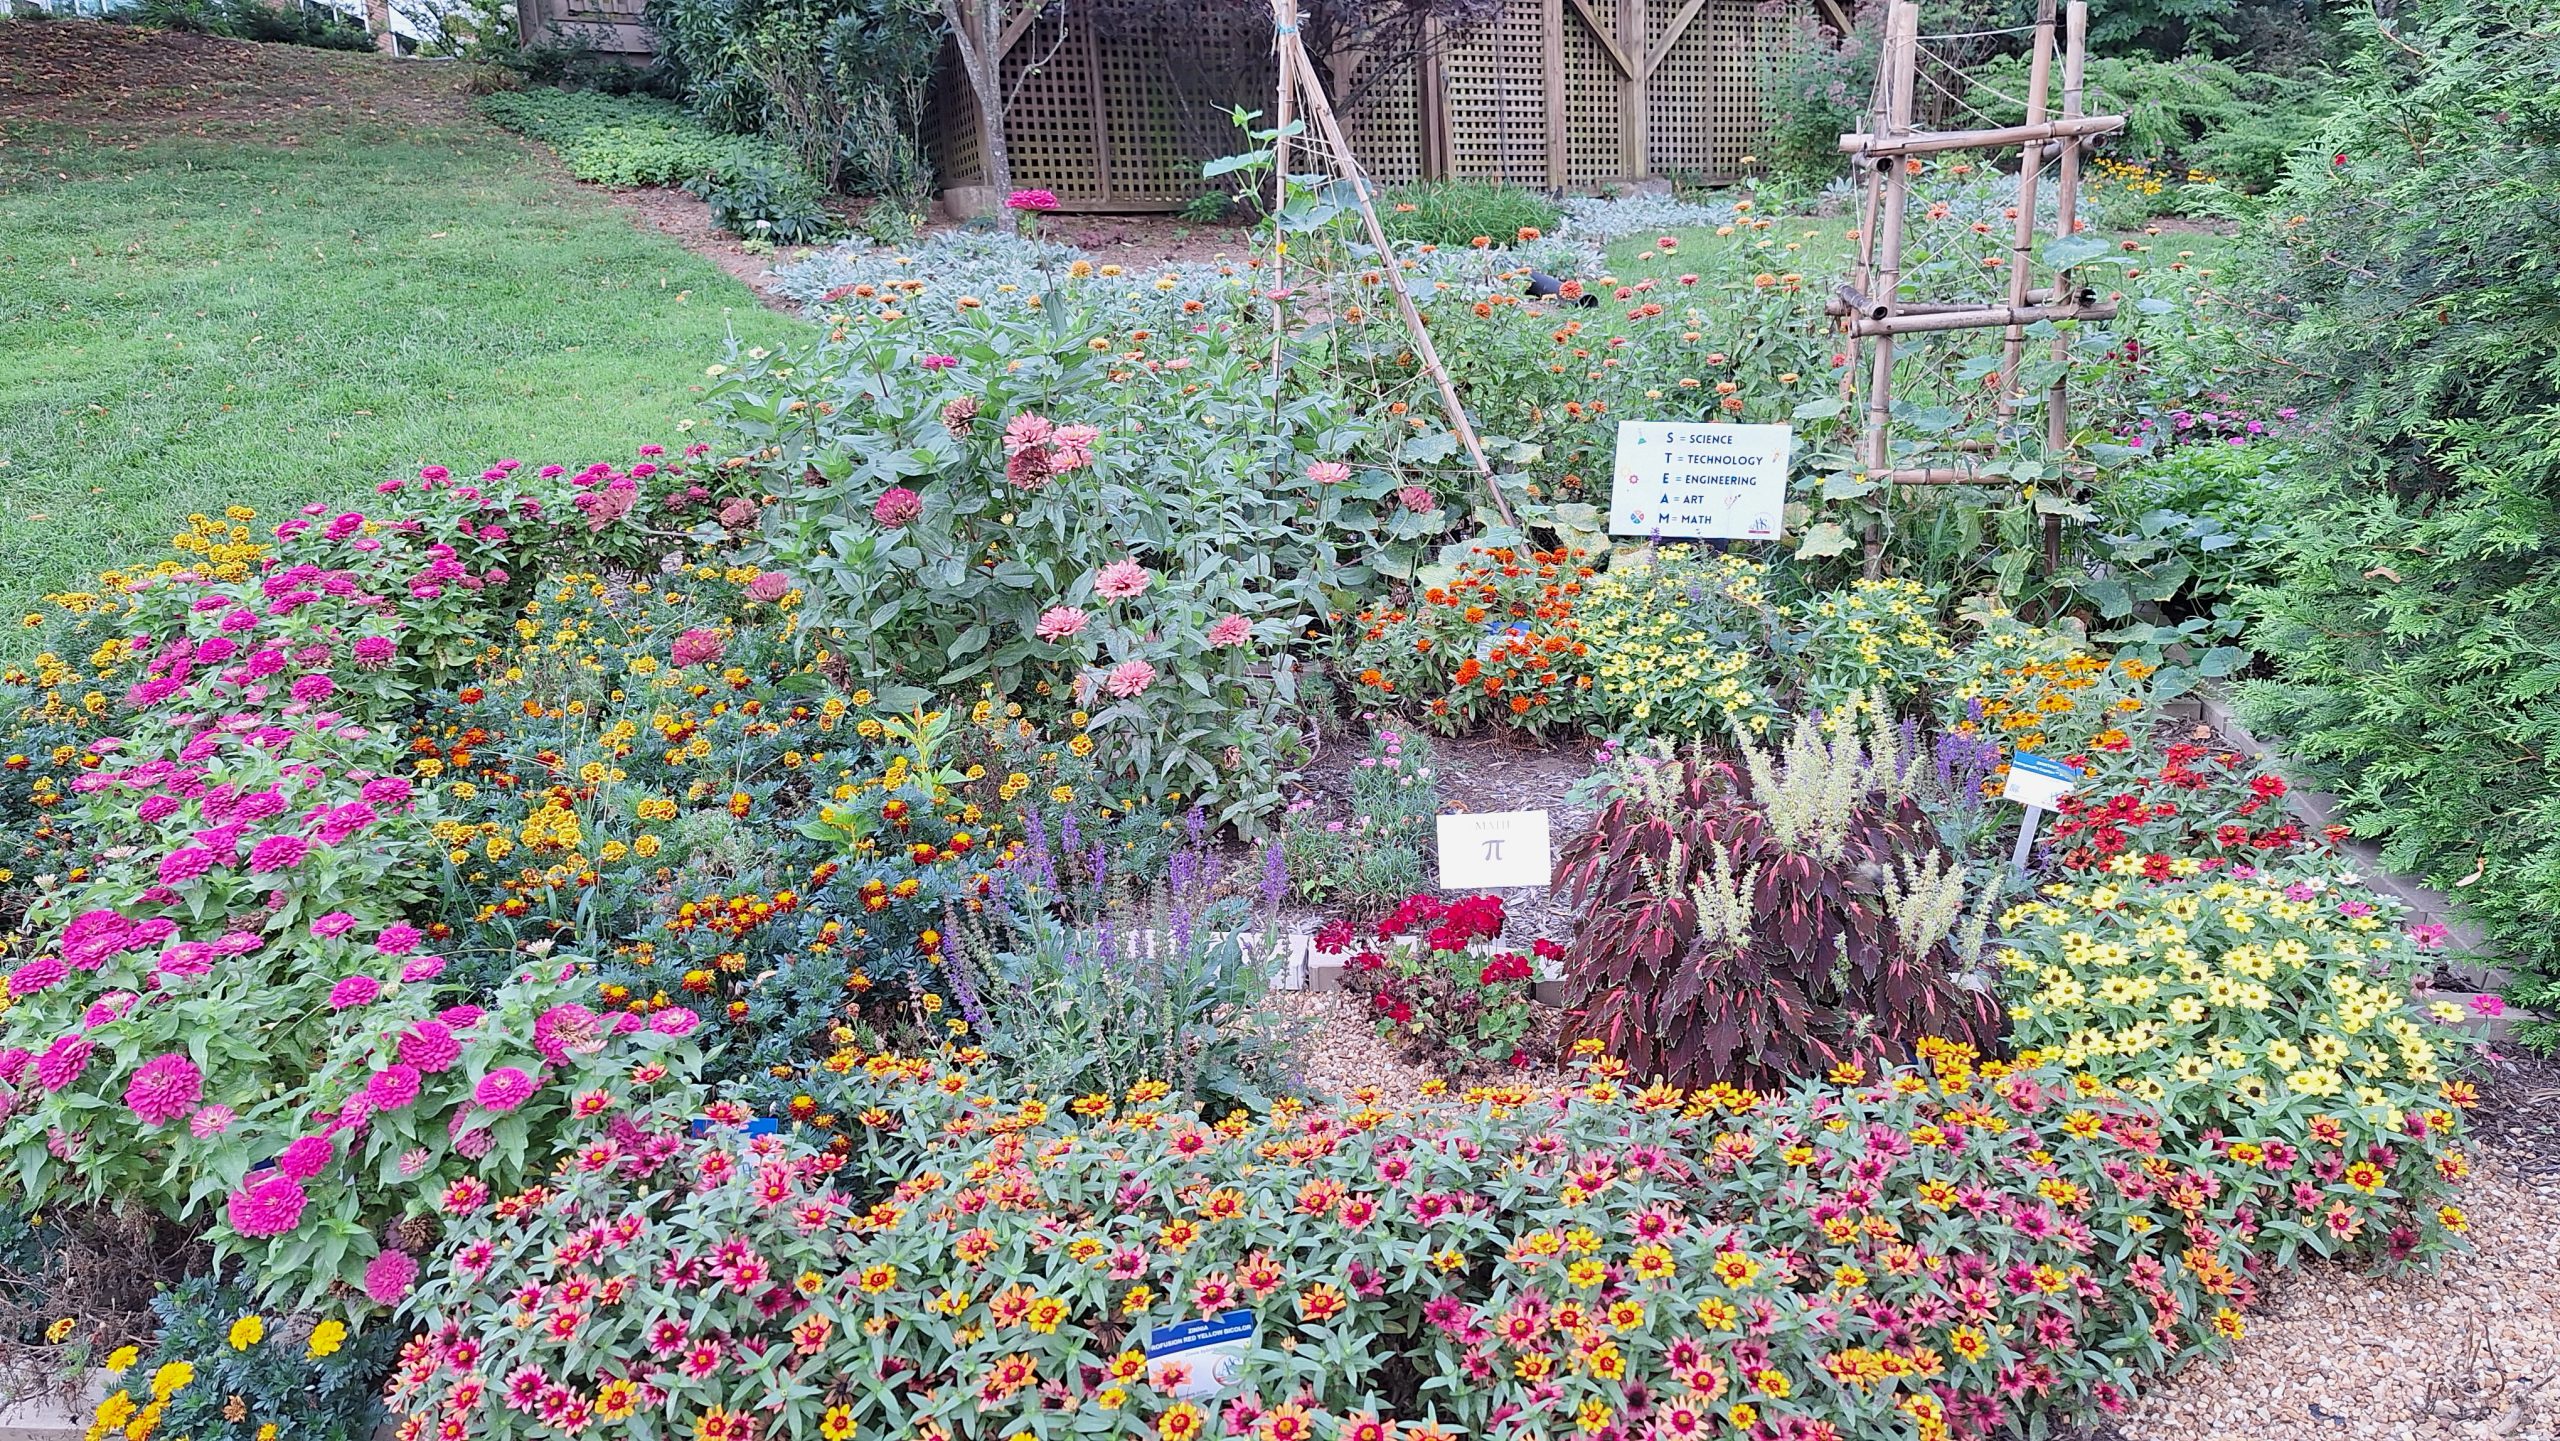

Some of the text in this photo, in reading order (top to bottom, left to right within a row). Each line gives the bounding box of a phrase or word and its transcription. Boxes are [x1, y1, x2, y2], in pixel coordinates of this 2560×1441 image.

[1666, 432, 1674, 444] S
[1689, 434, 1733, 445] SCIENCE
[1665, 452, 1672, 464] T
[1688, 454, 1763, 466] TECHNOLOGY
[1662, 472, 1670, 484] E
[1685, 474, 1757, 486] ENGINEERING
[1660, 493, 1669, 504] A
[1683, 495, 1704, 504] ART
[1658, 513, 1670, 524] M
[1681, 515, 1712, 525] MATH
[1188, 1325, 1208, 1334] ZINNIA
[1149, 1324, 1252, 1351] ROFUSION RED YELLOW BICOLOR
